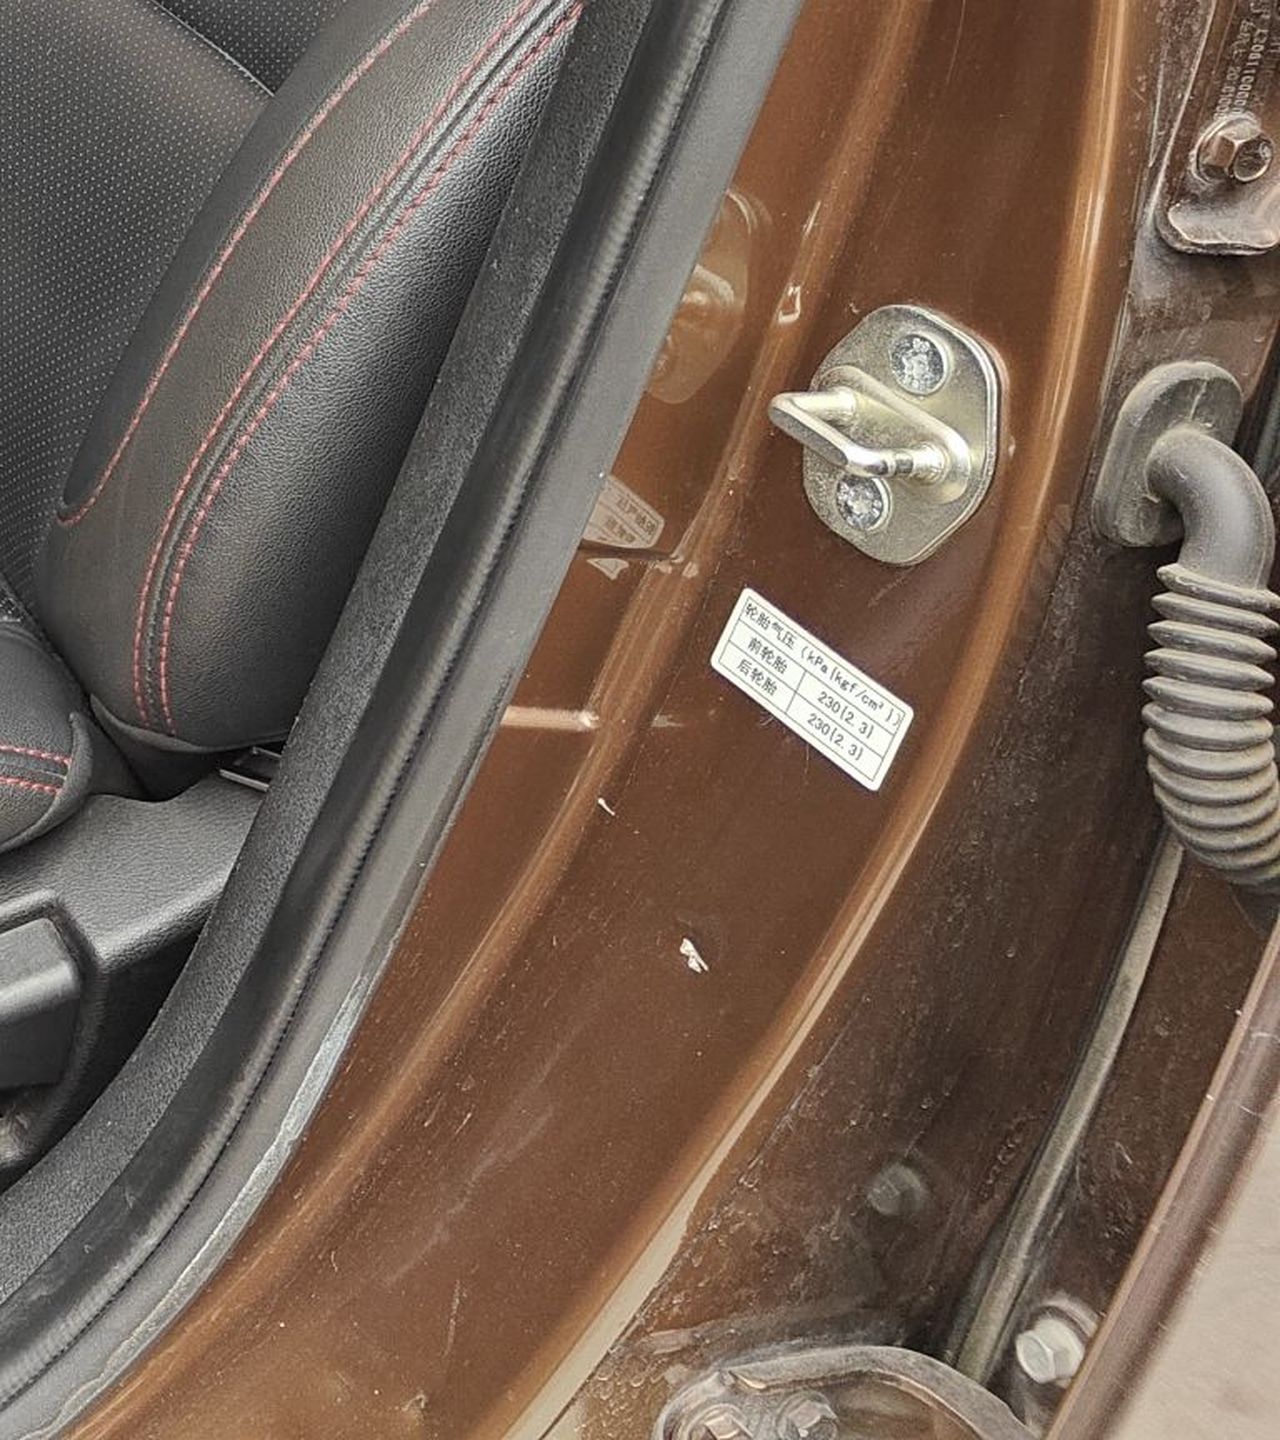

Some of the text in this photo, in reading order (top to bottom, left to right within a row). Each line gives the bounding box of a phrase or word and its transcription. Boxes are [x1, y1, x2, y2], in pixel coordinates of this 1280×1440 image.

[748, 637, 788, 674] 前轮胎
[737, 659, 778, 696] 后轮胎
